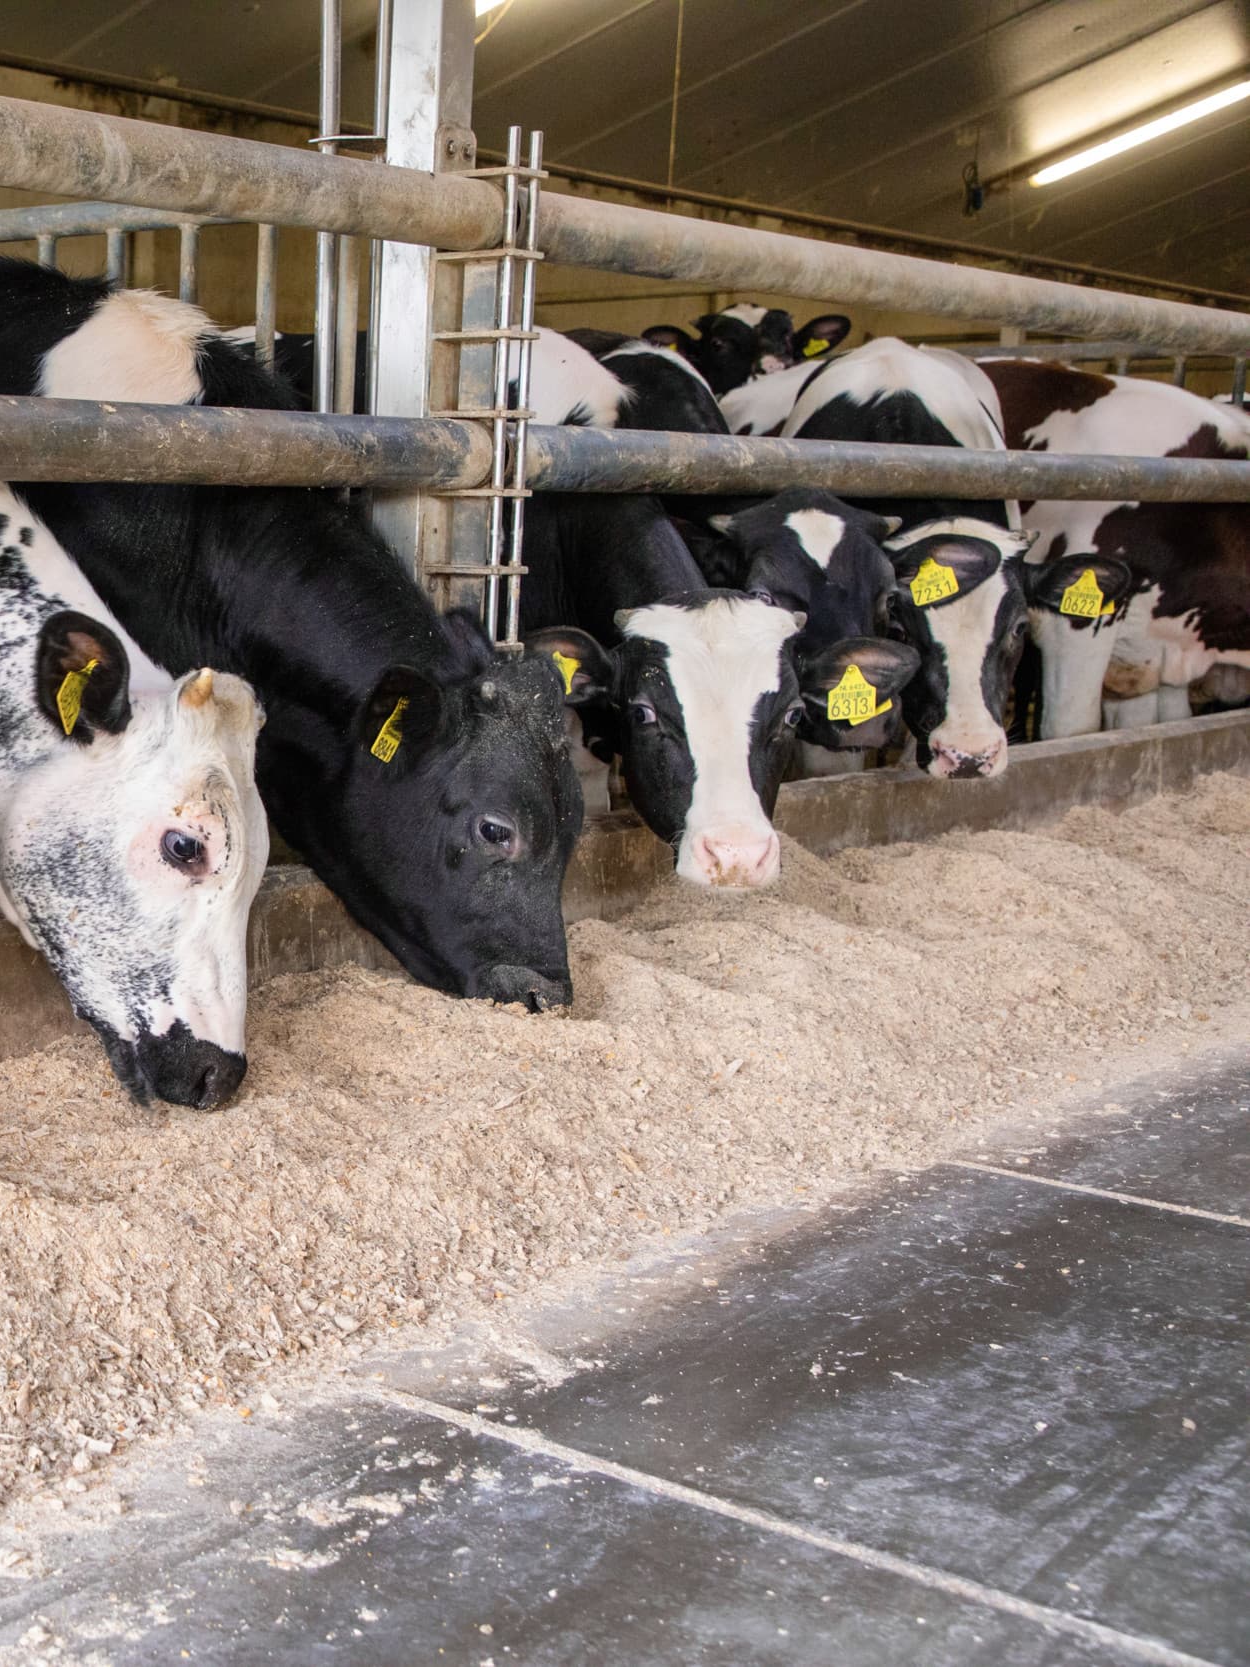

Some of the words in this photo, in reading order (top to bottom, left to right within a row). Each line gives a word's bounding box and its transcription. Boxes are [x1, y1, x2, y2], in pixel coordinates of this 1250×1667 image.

[914, 579, 952, 604] 7231
[1063, 596, 1095, 616] 0622
[831, 697, 869, 718] 6313
